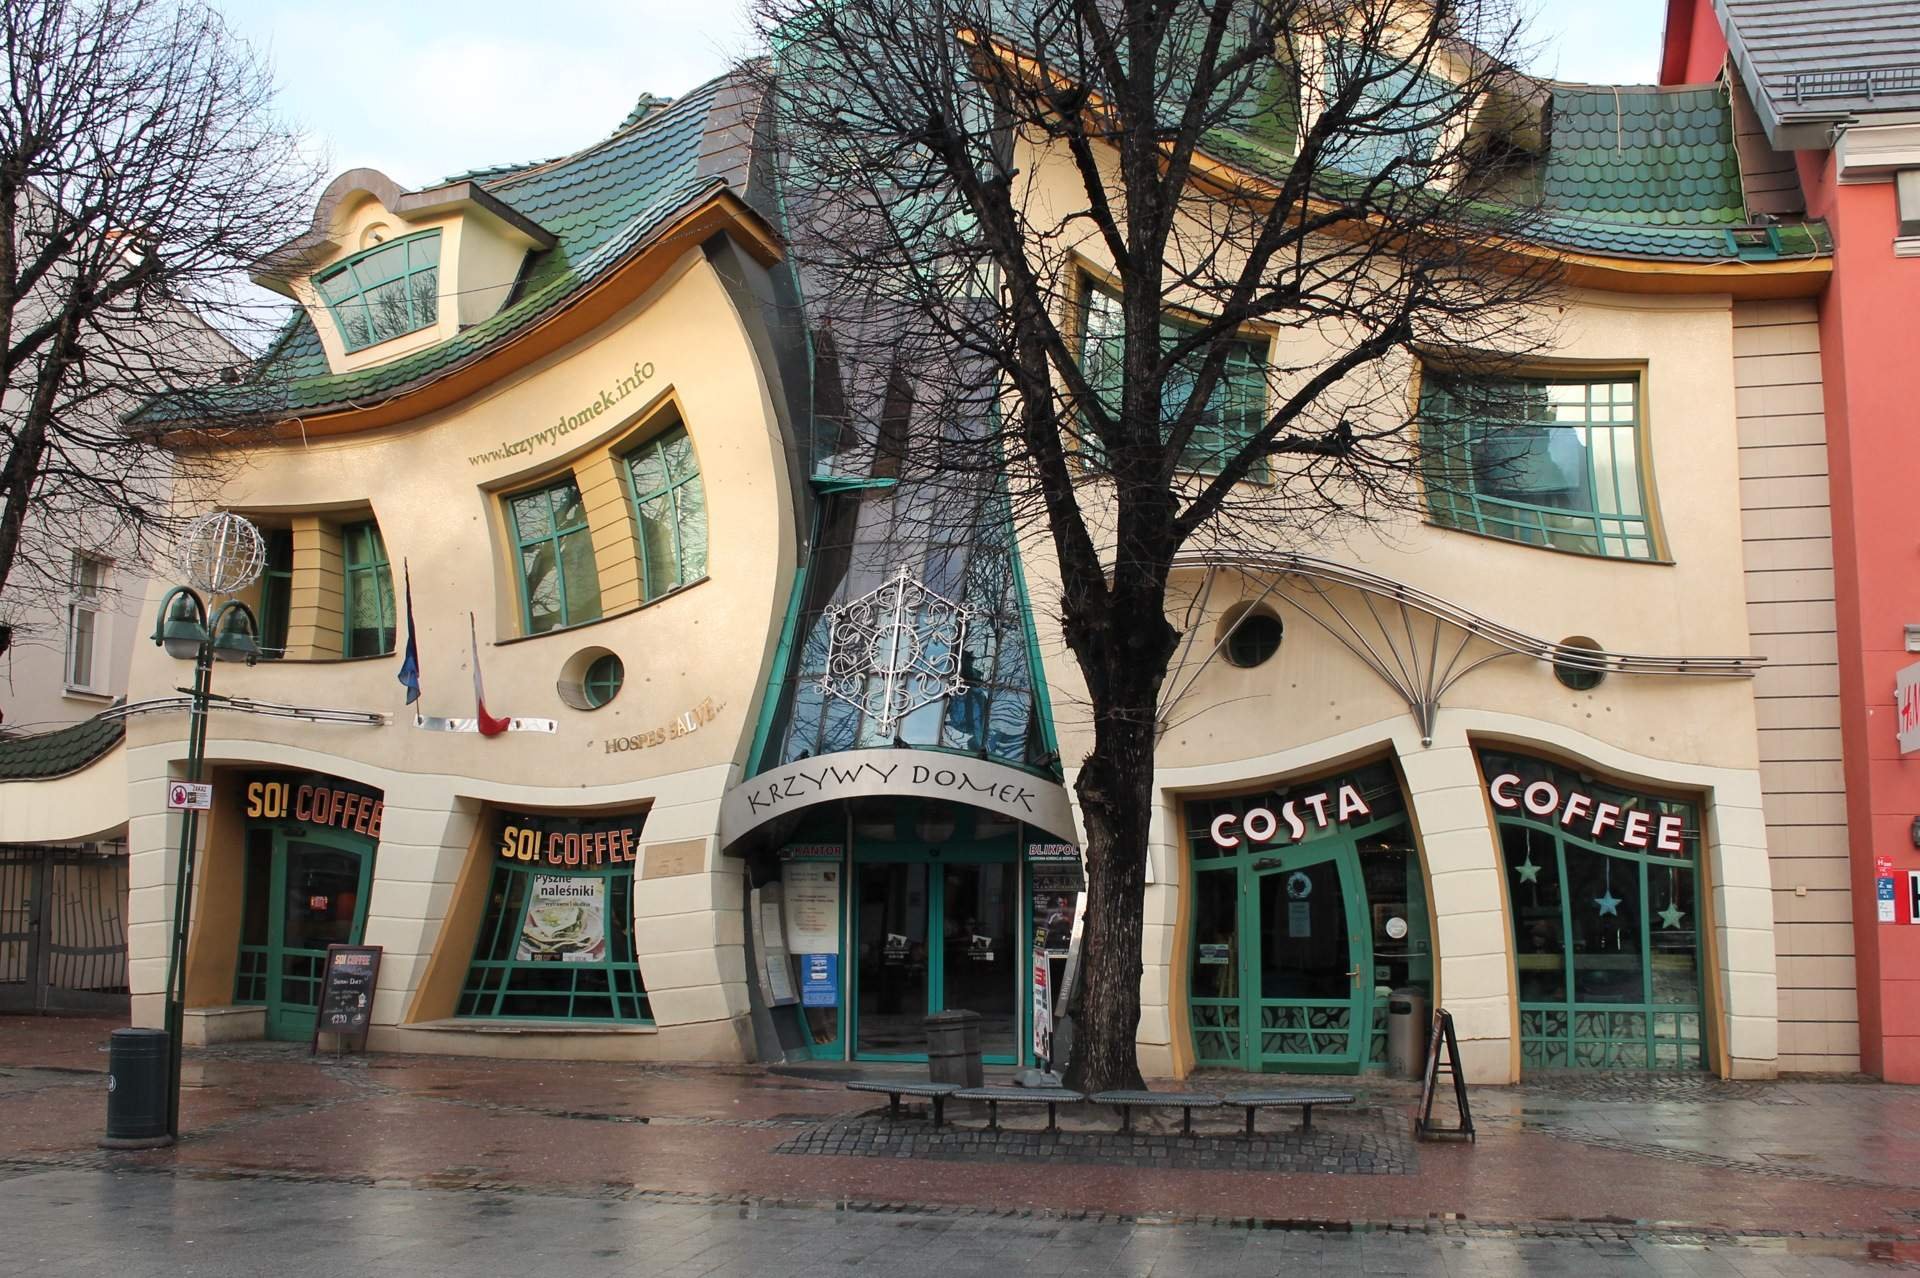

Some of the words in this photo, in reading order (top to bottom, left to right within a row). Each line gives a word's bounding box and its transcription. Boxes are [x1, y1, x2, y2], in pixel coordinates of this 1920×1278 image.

[468, 361, 656, 467] www.krzywydomek.info
[605, 727, 666, 754] HOSPES
[747, 763, 898, 815] KRZYWY
[911, 765, 1036, 813] DOMEK
[247, 782, 290, 818] SO!
[296, 784, 384, 838] COFFEE
[1210, 784, 1372, 849] COSTA
[1489, 773, 1684, 852] COFFEE
[501, 825, 542, 861] SO!
[548, 828, 638, 865] COFFEE
[1028, 844, 1079, 856] BLIKPOL
[535, 874, 572, 885] Pyszne
[541, 884, 594, 897] naleśniki
